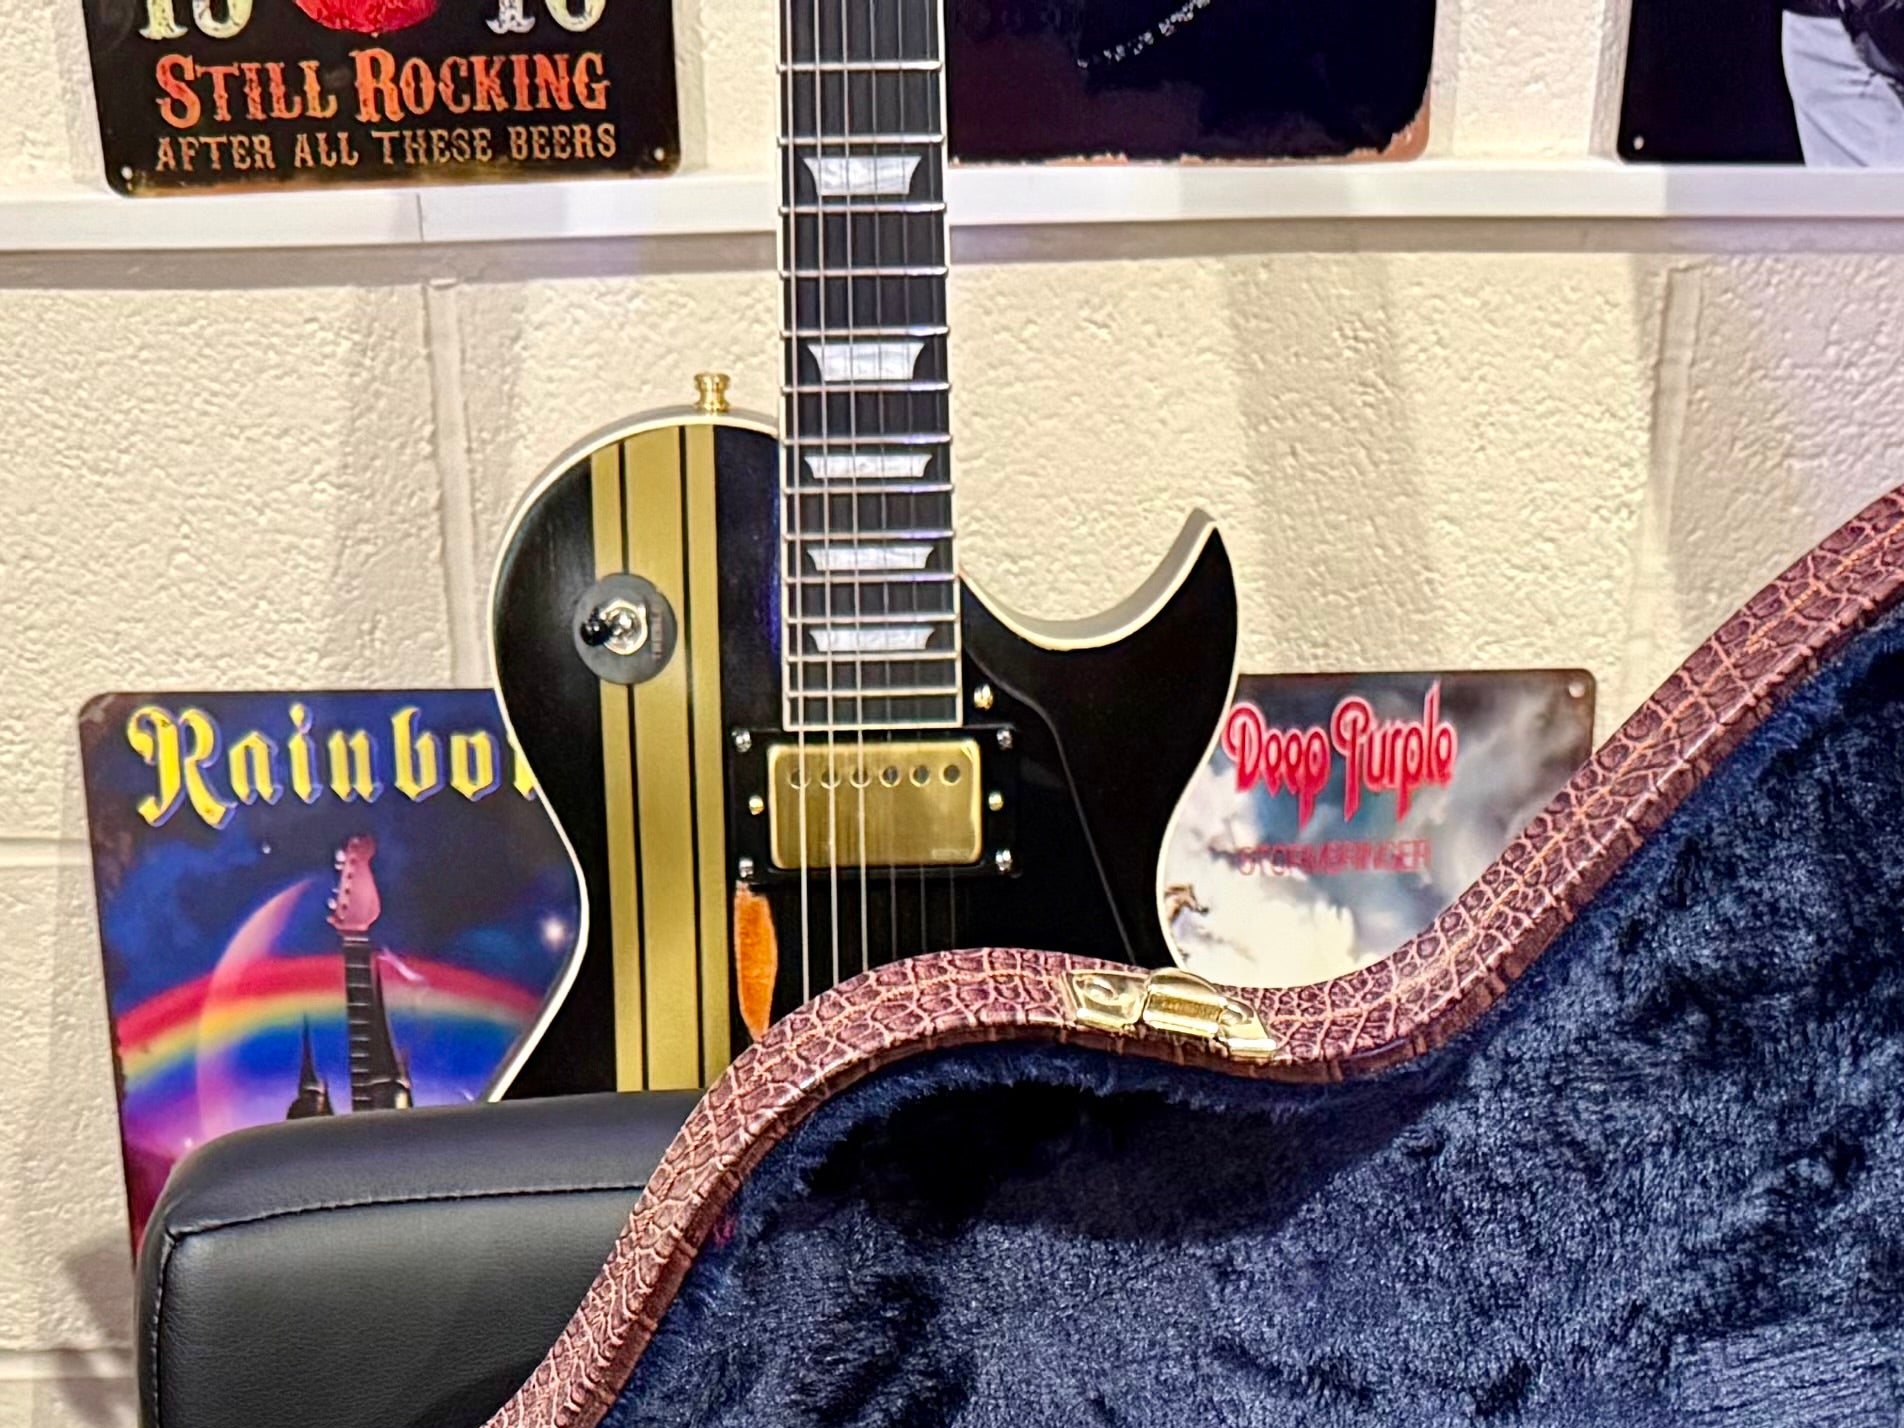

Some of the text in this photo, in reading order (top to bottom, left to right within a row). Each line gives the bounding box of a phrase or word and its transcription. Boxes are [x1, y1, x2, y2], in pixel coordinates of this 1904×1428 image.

[155, 47, 613, 129] STILL ROCKING
[156, 123, 617, 173] AFTER ALL THESE BEERS
[1220, 679, 1458, 832] Deep Purple
